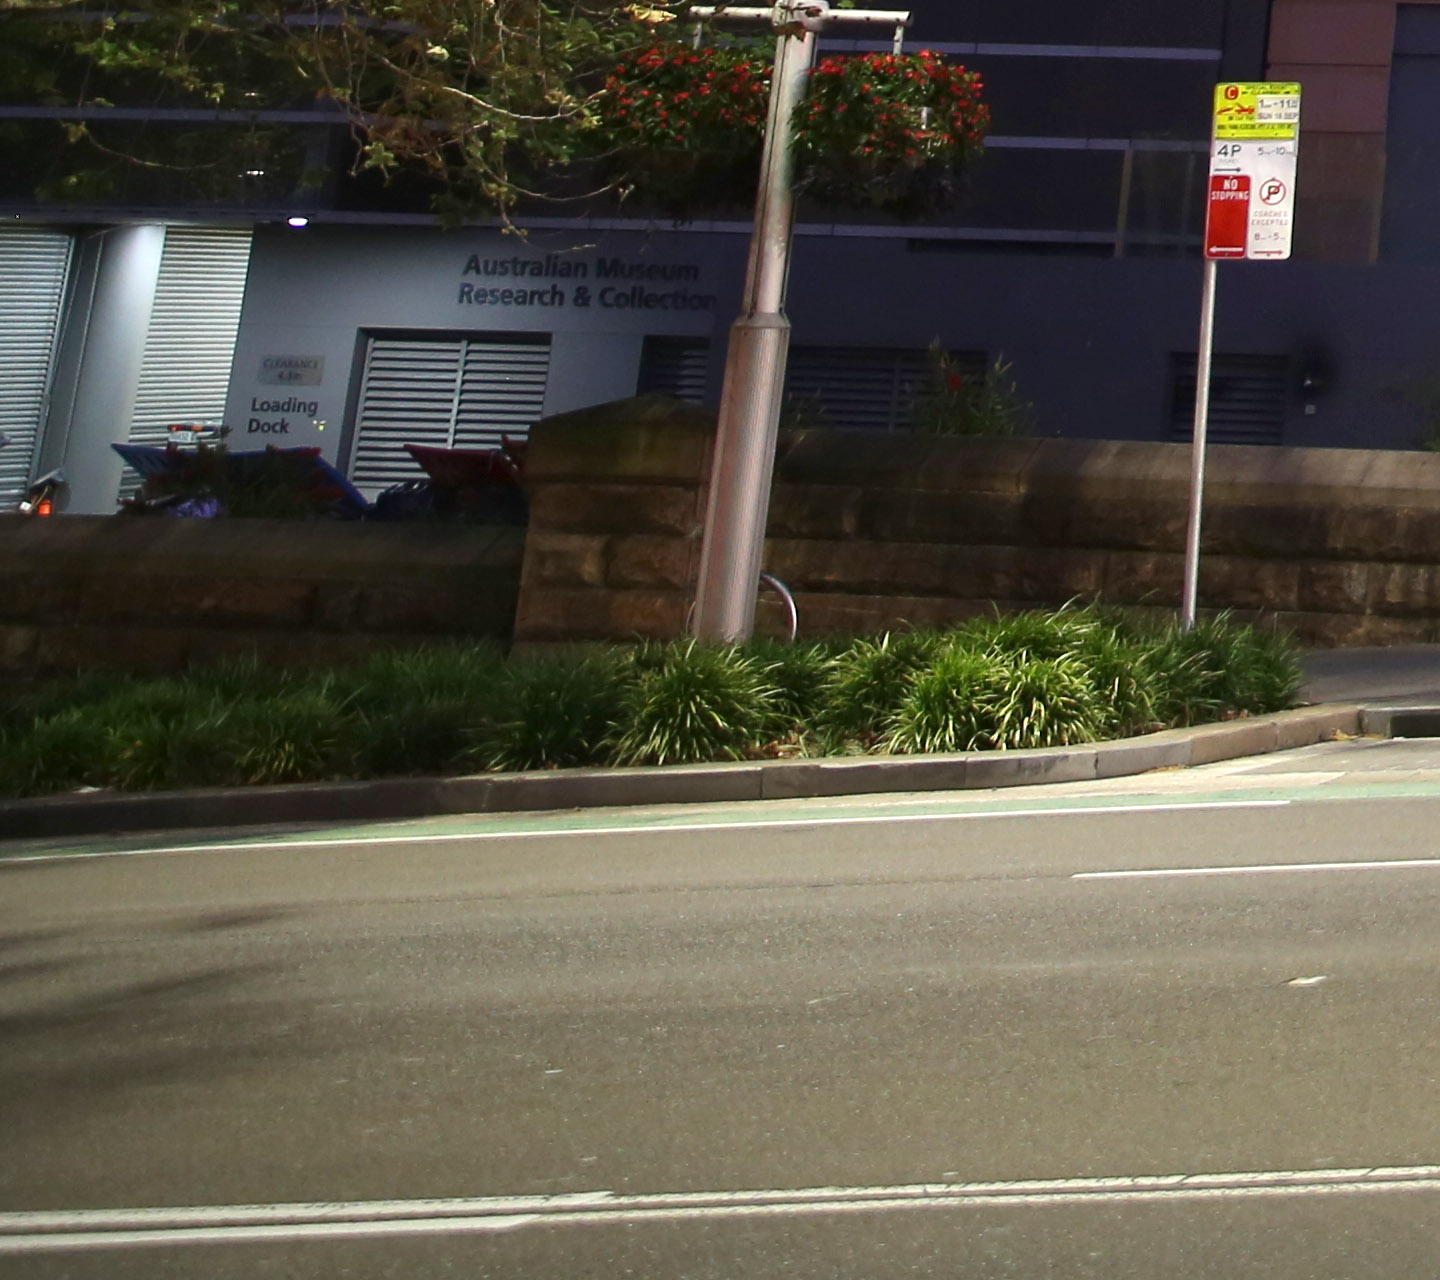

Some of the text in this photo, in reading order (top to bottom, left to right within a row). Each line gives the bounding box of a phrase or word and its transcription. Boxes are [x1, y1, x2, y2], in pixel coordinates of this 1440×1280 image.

[1217, 144, 1242, 157] 4P
[1223, 179, 1238, 190] NO
[1211, 190, 1249, 200] STOPPING
[462, 254, 700, 281] Australian Museum
[457, 282, 565, 307] Research
[573, 285, 591, 307] &
[251, 397, 319, 418] Loading
[247, 418, 290, 434] Dock
